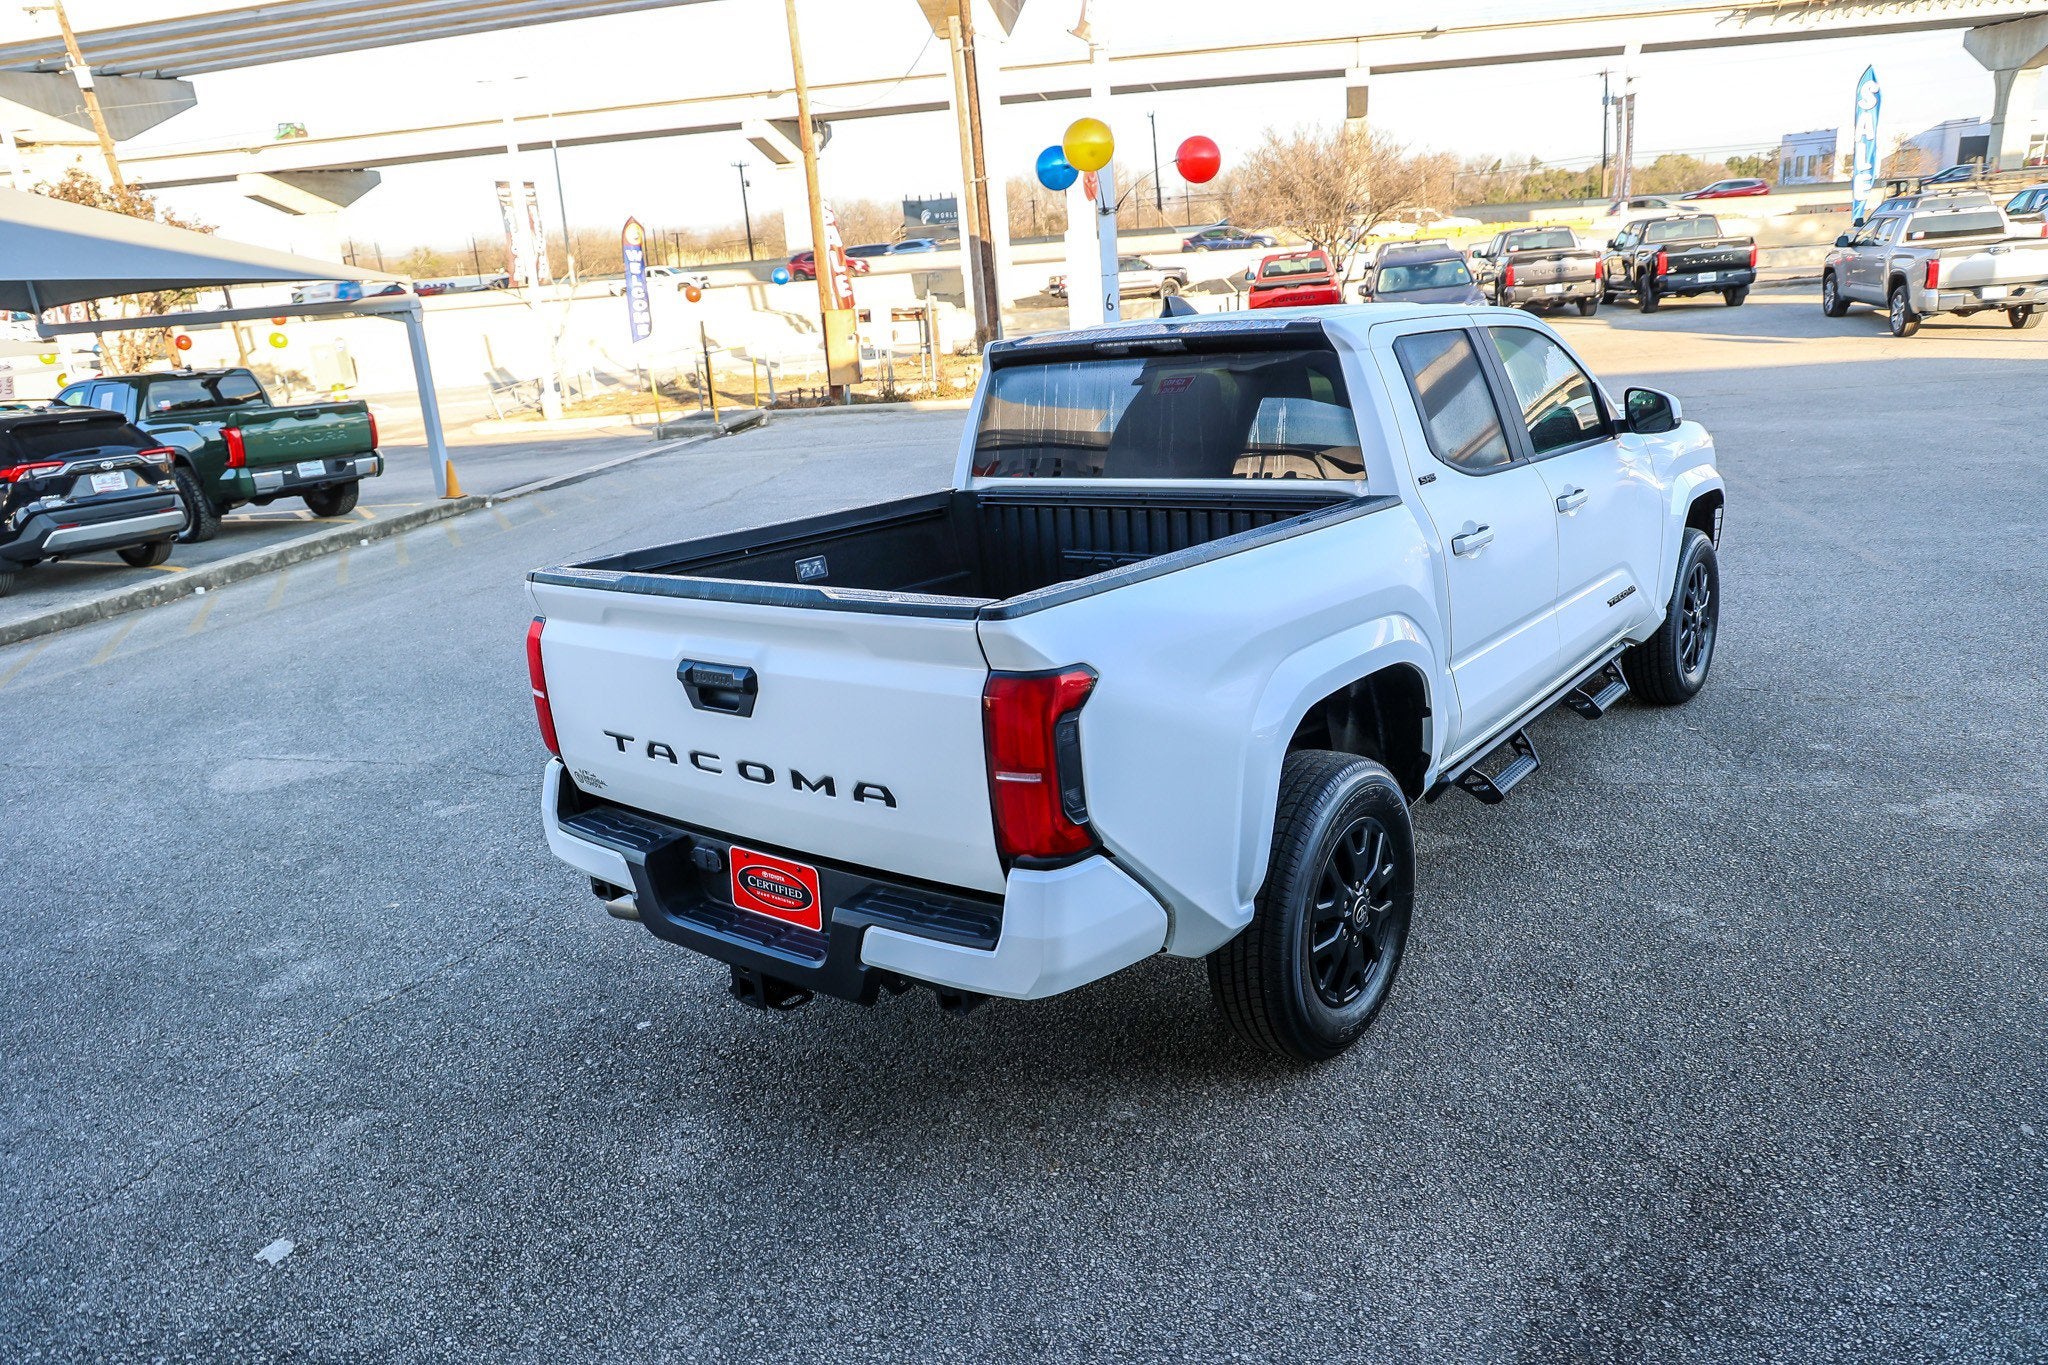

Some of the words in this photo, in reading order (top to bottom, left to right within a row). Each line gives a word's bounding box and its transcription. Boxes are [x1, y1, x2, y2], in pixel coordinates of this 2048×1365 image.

[1854, 79, 1880, 200] SALE
[1531, 265, 1578, 277] TUNDRA
[625, 249, 650, 336] WELCOME
[1106, 293, 1114, 311] 6
[695, 672, 733, 686] TOYOTA
[603, 729, 898, 808] TACOMA
[767, 873, 785, 882] TOYOTA
[747, 875, 803, 899] CERTIFIED
[757, 890, 770, 898] Used
[771, 894, 795, 905] Vehicles
